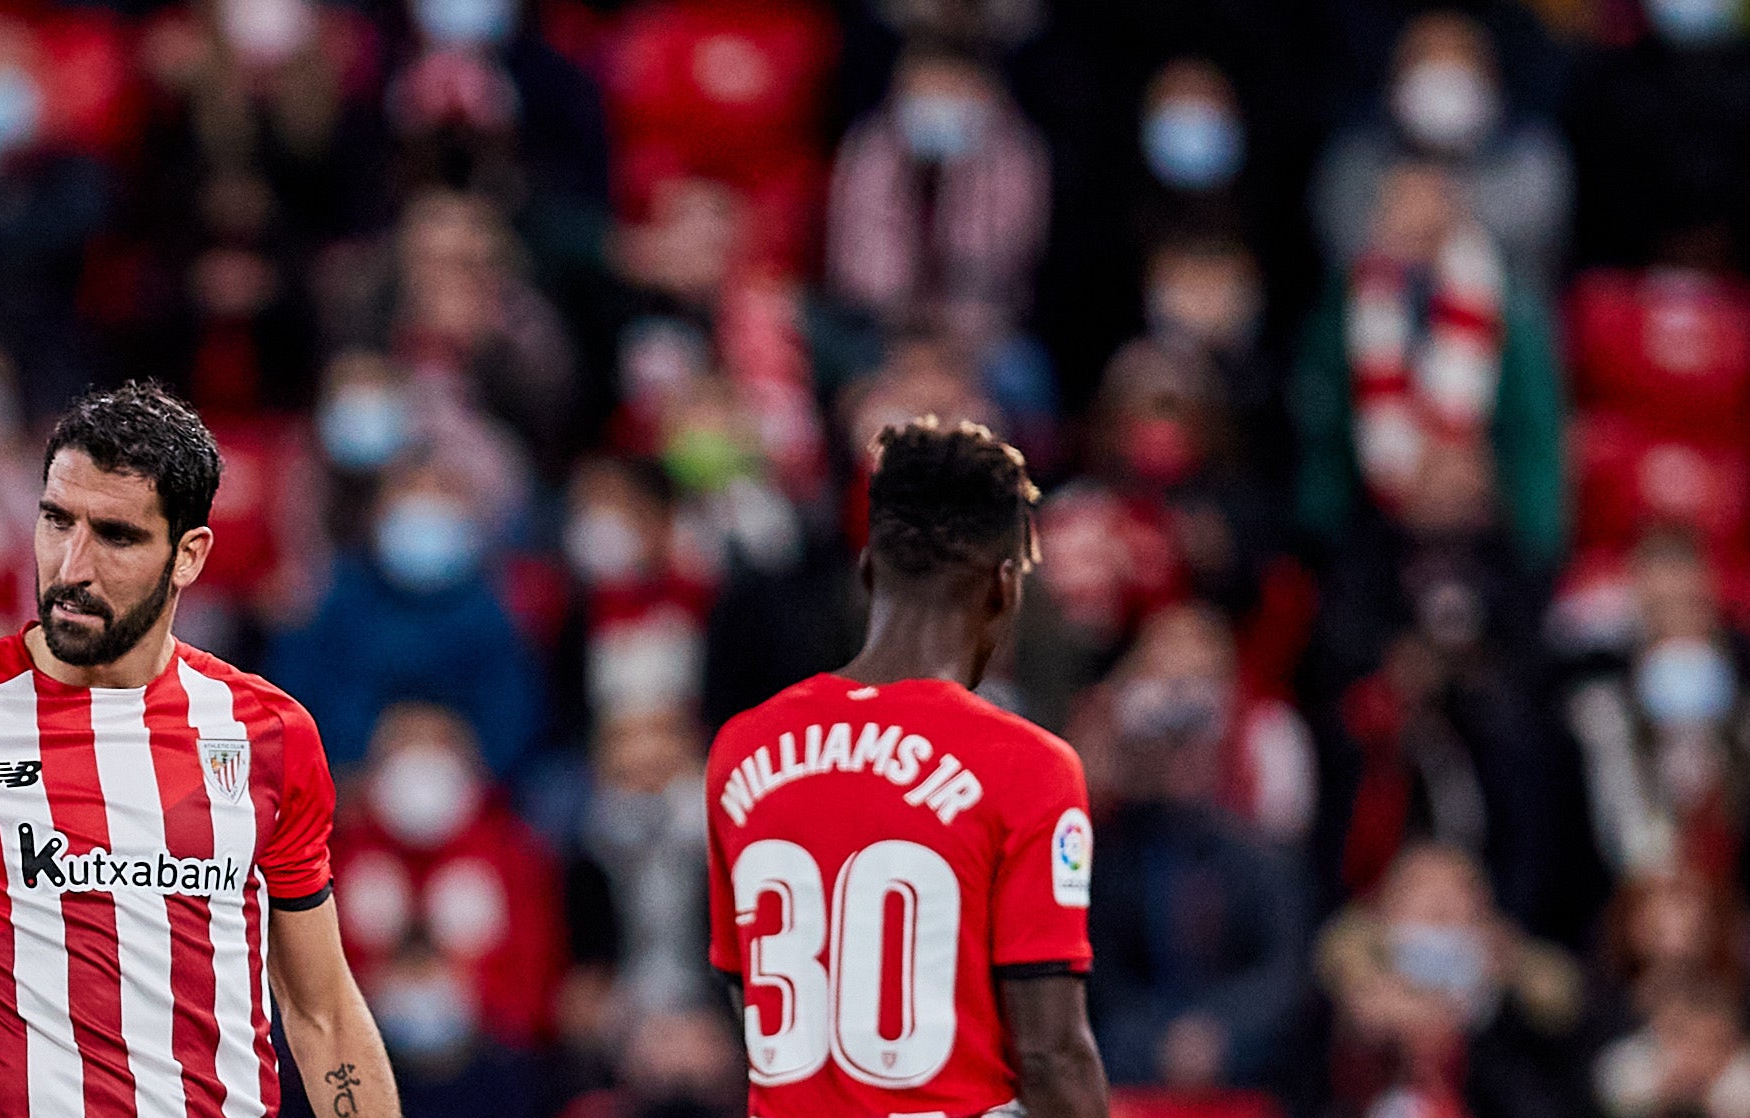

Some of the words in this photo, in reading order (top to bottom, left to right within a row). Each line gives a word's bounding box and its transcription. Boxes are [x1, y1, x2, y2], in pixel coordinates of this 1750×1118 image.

[720, 722, 934, 828] WILLIAMS
[903, 752, 985, 826] JR
[18, 822, 240, 891] Kutxabank
[731, 838, 962, 1091] 30
